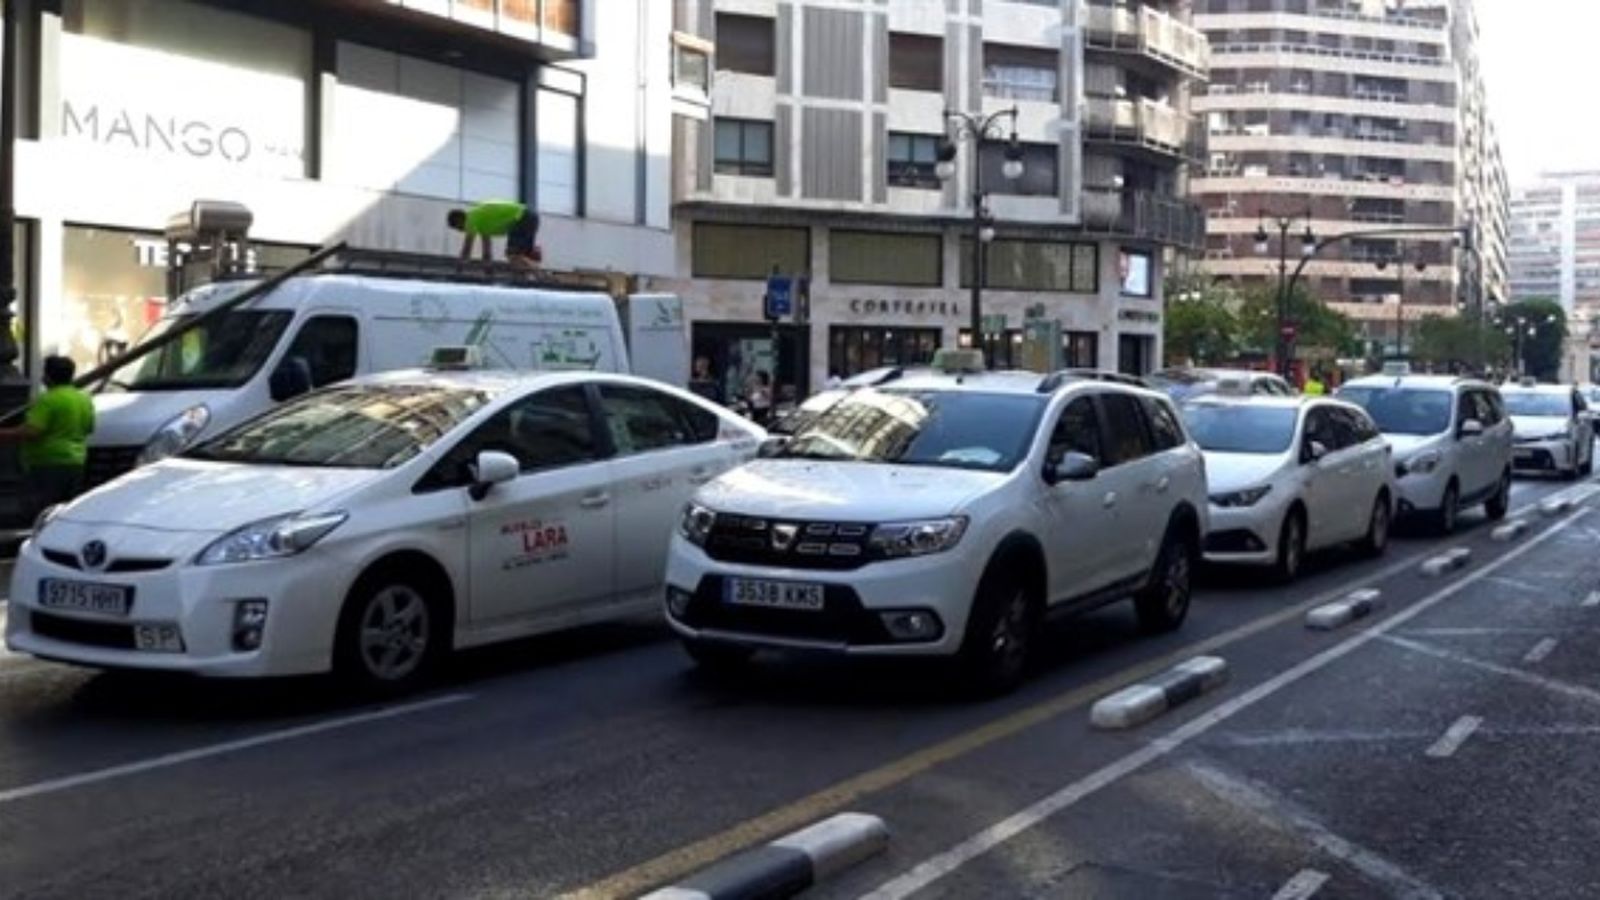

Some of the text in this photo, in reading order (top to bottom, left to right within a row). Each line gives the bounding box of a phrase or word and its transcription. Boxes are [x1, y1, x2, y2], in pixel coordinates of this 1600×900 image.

[62, 99, 250, 162] MANGO
[850, 299, 959, 316] CORTEFIEL
[523, 525, 569, 553] LARA
[50, 582, 87, 606] 9715
[735, 580, 819, 606] 3538 KMS
